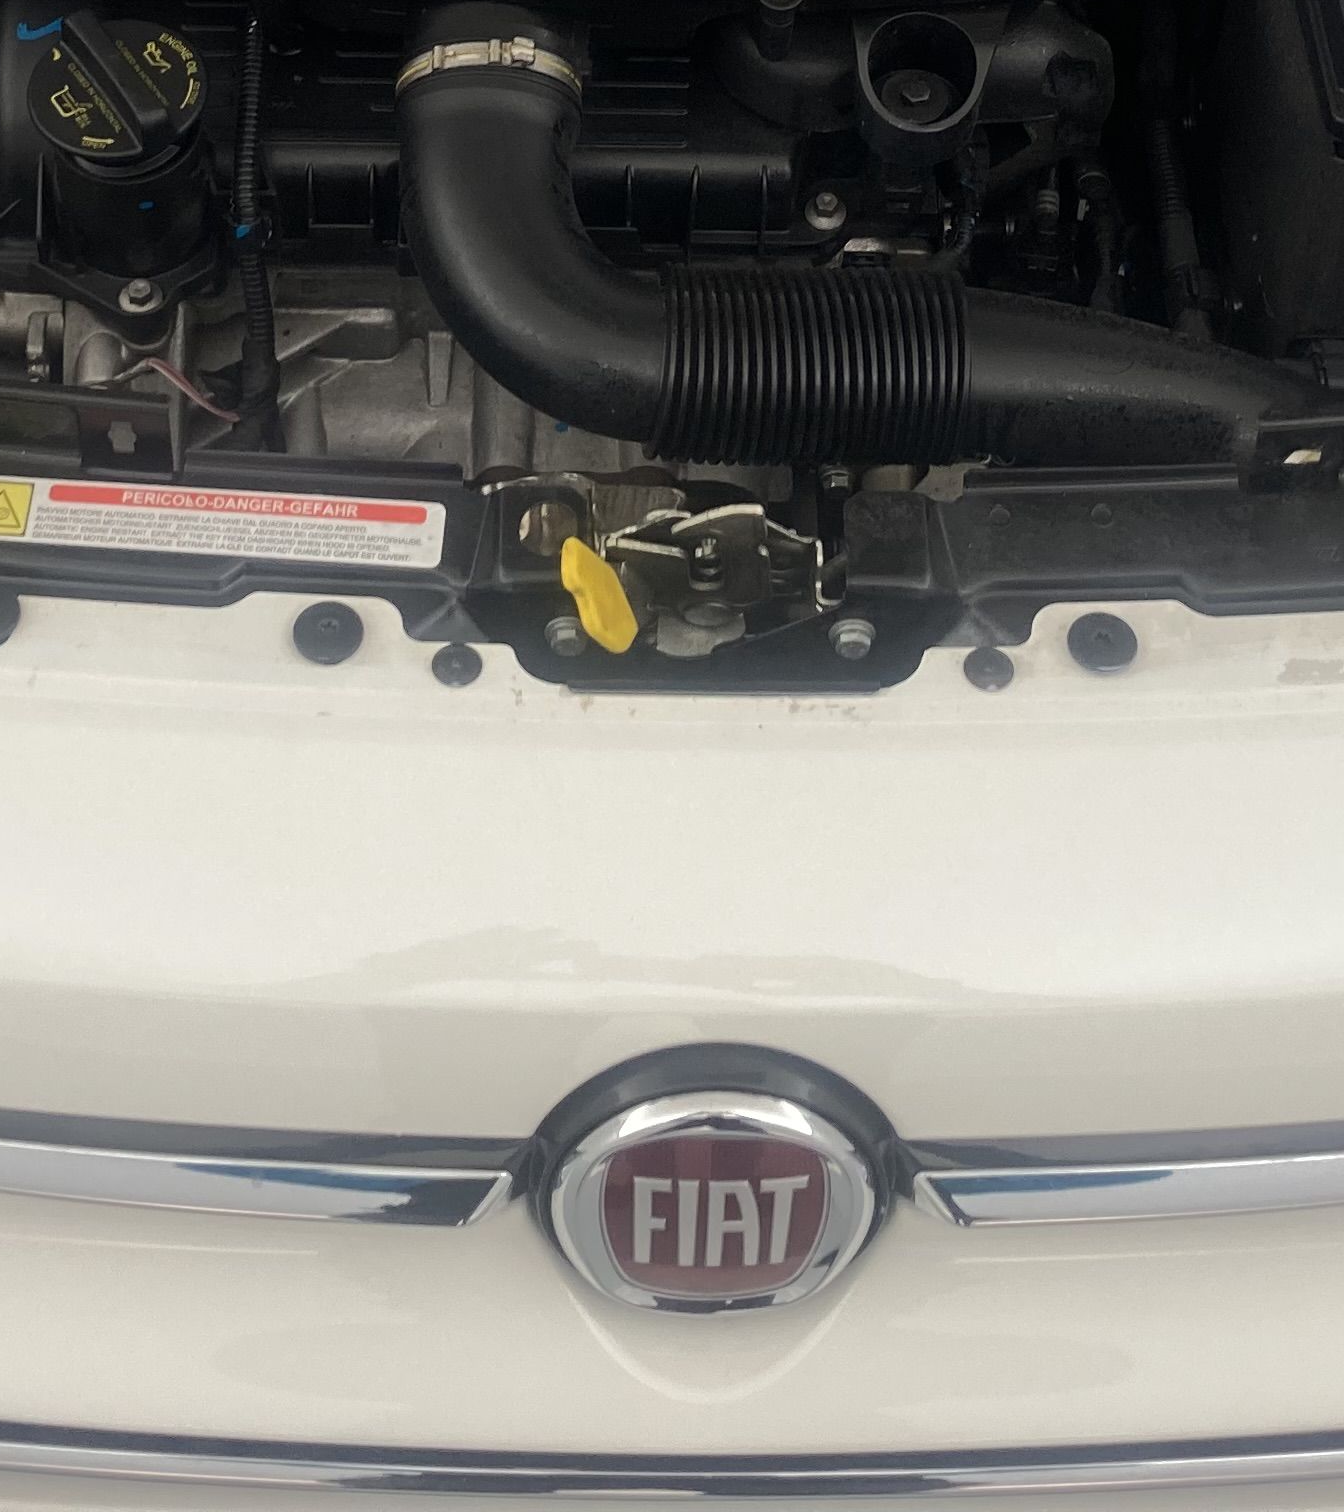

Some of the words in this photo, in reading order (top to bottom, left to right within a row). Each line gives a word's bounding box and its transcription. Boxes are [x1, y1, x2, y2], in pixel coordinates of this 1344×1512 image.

[159, 32, 194, 61] ENGINE
[121, 490, 359, 518] PERICOLO-DANGER-GEFAHR
[33, 523, 78, 533] AUTOMATIC
[222, 534, 247, 543] FROM
[297, 539, 322, 548] WHEN
[322, 541, 346, 550] HOOD
[632, 1174, 811, 1267] FIAT
